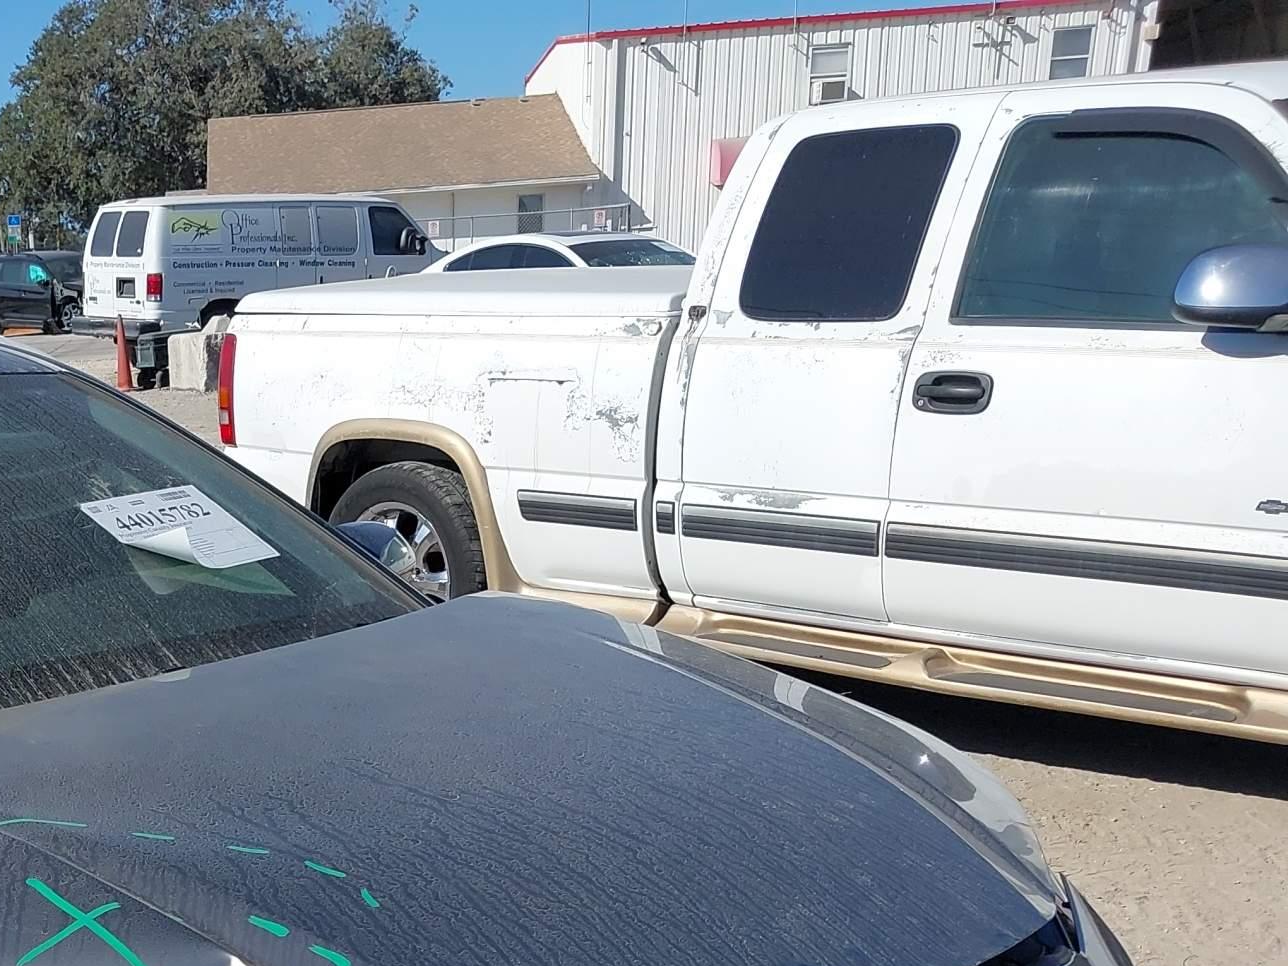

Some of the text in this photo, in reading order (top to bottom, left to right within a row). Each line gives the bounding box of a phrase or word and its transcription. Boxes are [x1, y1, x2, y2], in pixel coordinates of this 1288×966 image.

[231, 245, 267, 254] Property
[172, 259, 356, 269] Construction Pressure Cleaning Window Cleaning
[115, 502, 212, 531] 44015782
